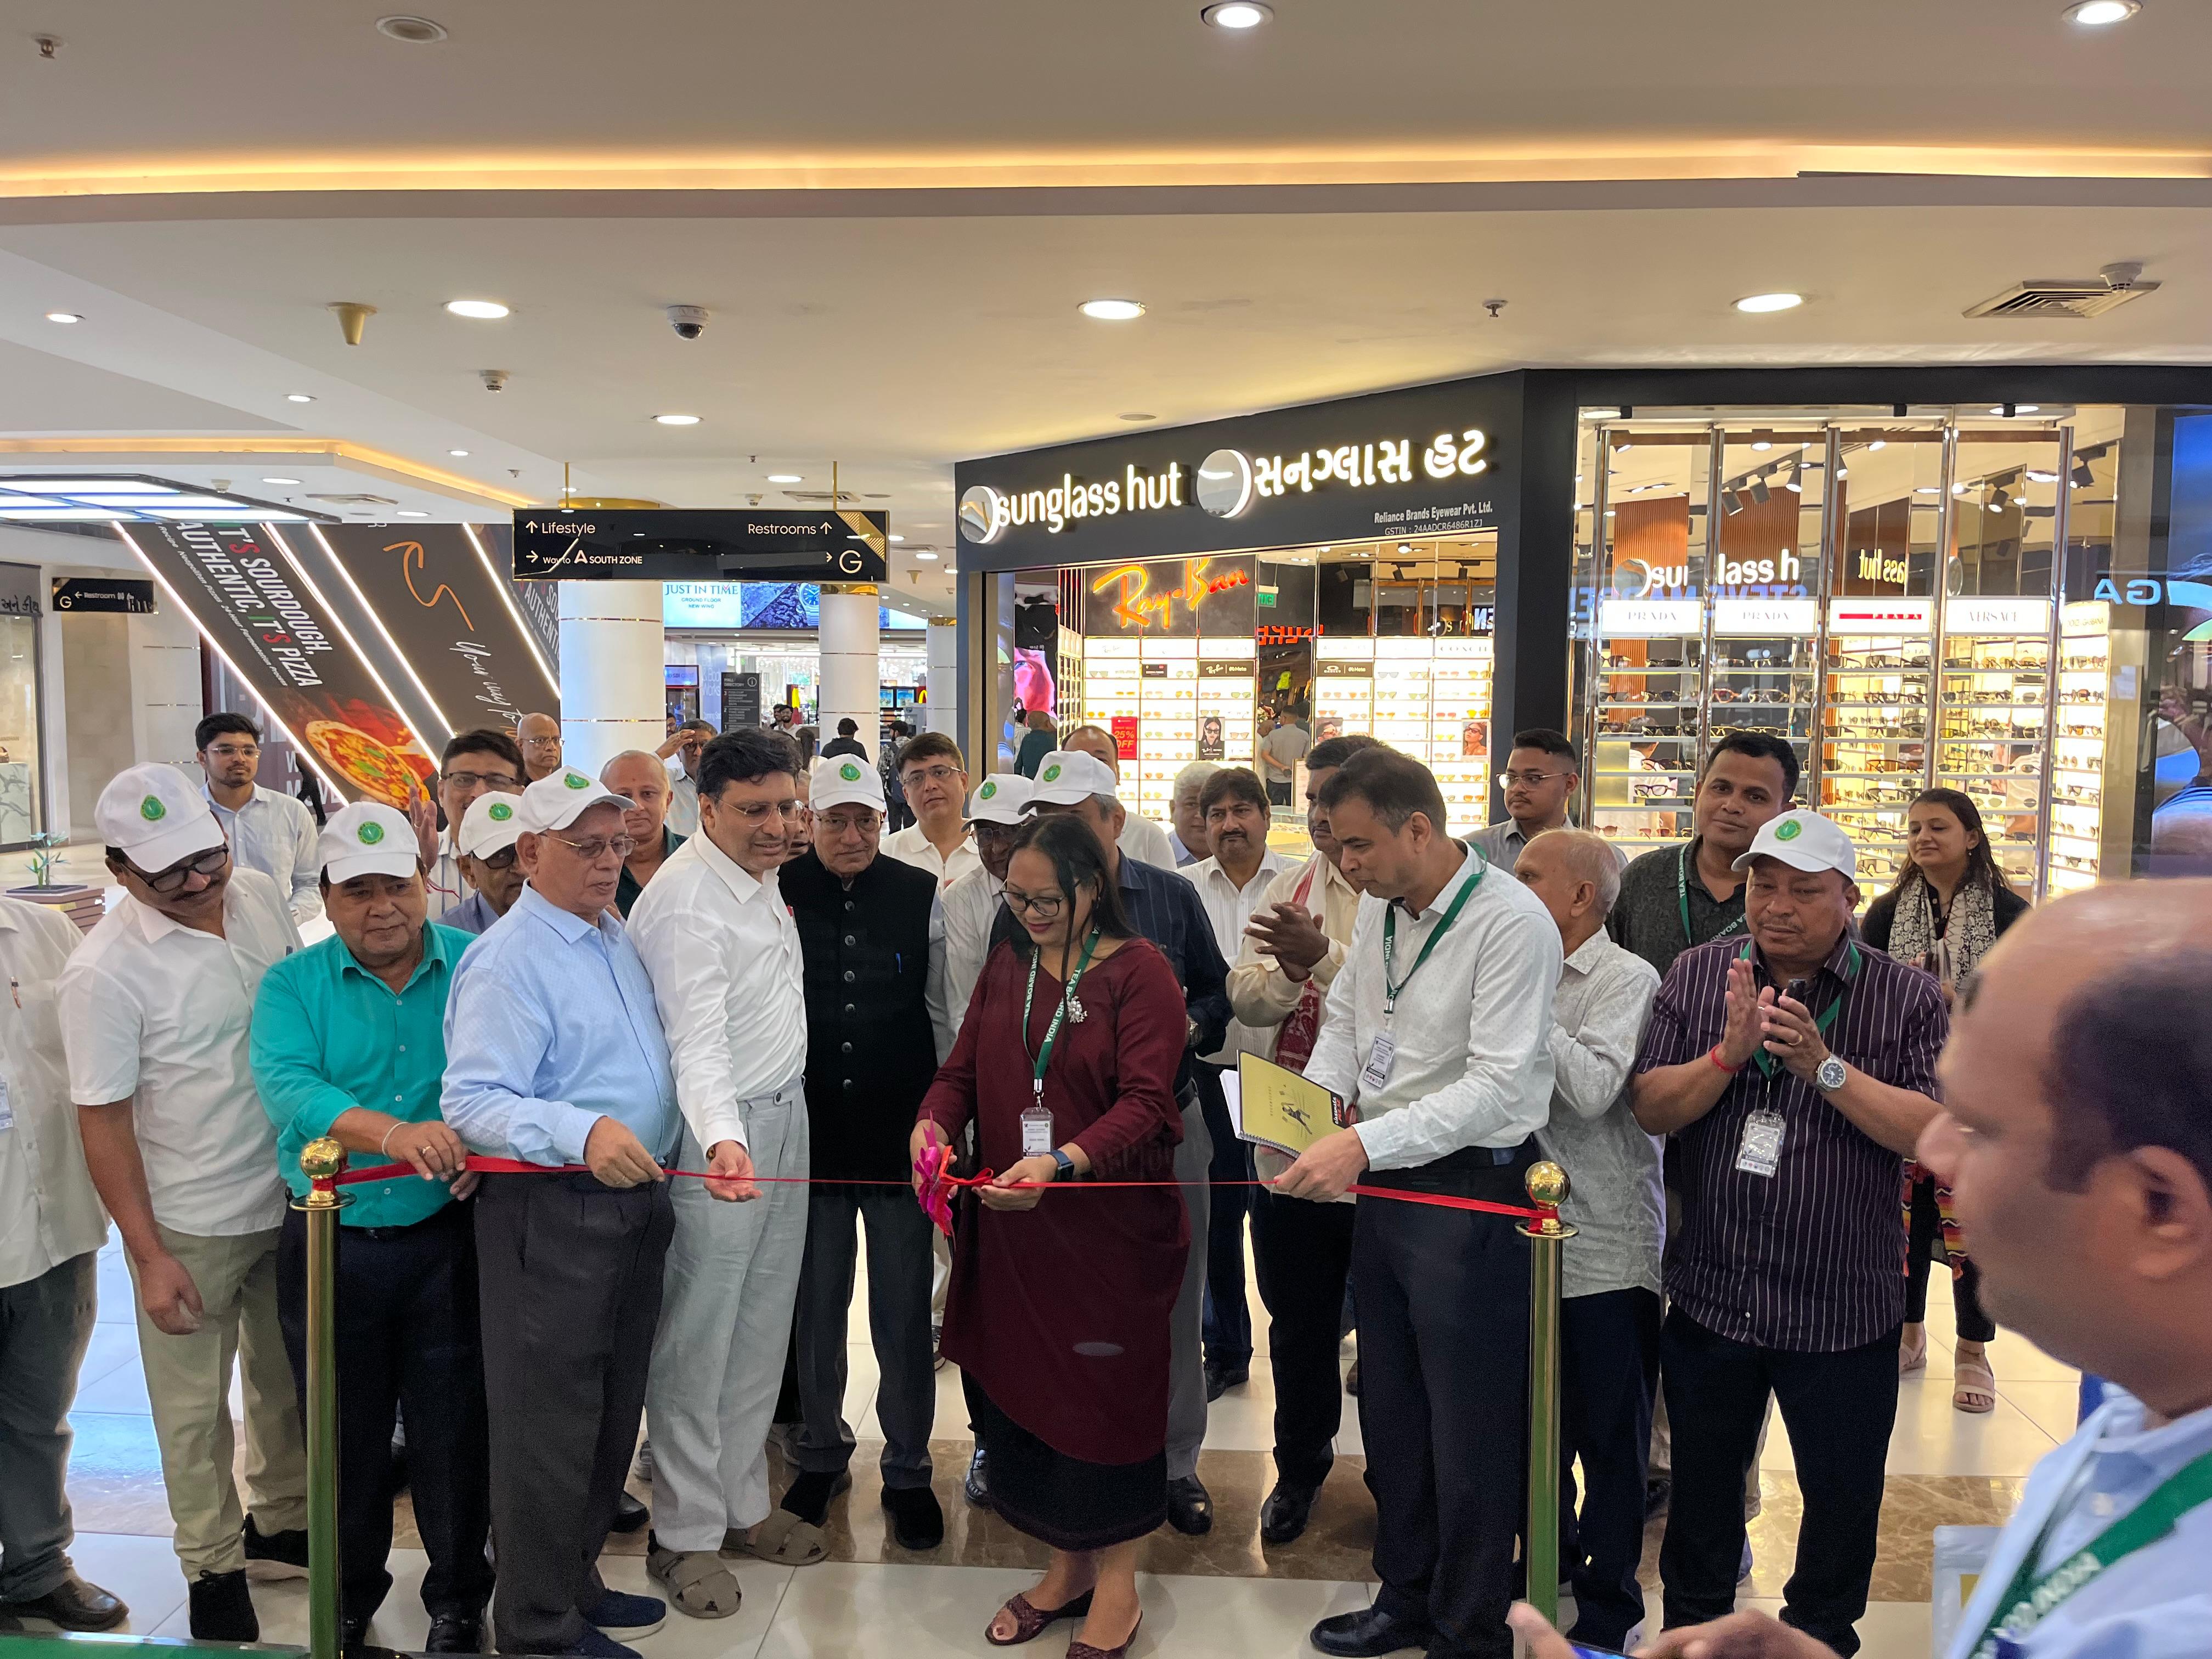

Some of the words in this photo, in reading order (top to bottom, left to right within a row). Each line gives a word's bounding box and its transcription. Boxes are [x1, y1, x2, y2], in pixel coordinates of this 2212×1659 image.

[1255, 438, 1413, 497] સનગ્લાસ
[997, 473, 1121, 533] sunglass
[1126, 461, 1182, 511] hut
[1374, 511, 1405, 523] Reliance
[1406, 507, 1430, 521] Brands
[1431, 506, 1462, 521] Eyewear
[1463, 503, 1477, 515] Pvt.
[1479, 500, 1493, 513] Ltd.
[541, 522, 596, 537] Lifestyle
[748, 523, 817, 535] Restrooms
[1384, 526, 1407, 536] GSTIN
[543, 556, 561, 565] Way
[589, 556, 618, 564] SOUTH
[619, 556, 642, 564] ZONE
[839, 550, 862, 573] G
[665, 585, 692, 595] JUST
[695, 585, 709, 594] IN
[710, 585, 738, 594] TIME
[1092, 556, 1249, 629] Ray-Ban
[60, 596, 72, 608] G
[176, 522, 265, 613] AUTHENTIC,
[247, 616, 292, 644] IT'S
[271, 647, 323, 687] PIZZA
[178, 549, 207, 584] Neapolitan
[240, 628, 272, 666] Fermentation
[240, 557, 333, 655] SOURDOUGH,
[1628, 612, 1677, 620] PRADA
[1742, 612, 1790, 620] PRADA
[1969, 611, 2018, 622] VERSACE
[1114, 730, 1135, 738] 25%
[1069, 969, 1082, 985] TEA
[1026, 970, 1036, 1003] BOARD
[1044, 1019, 1059, 1042] INDIA
